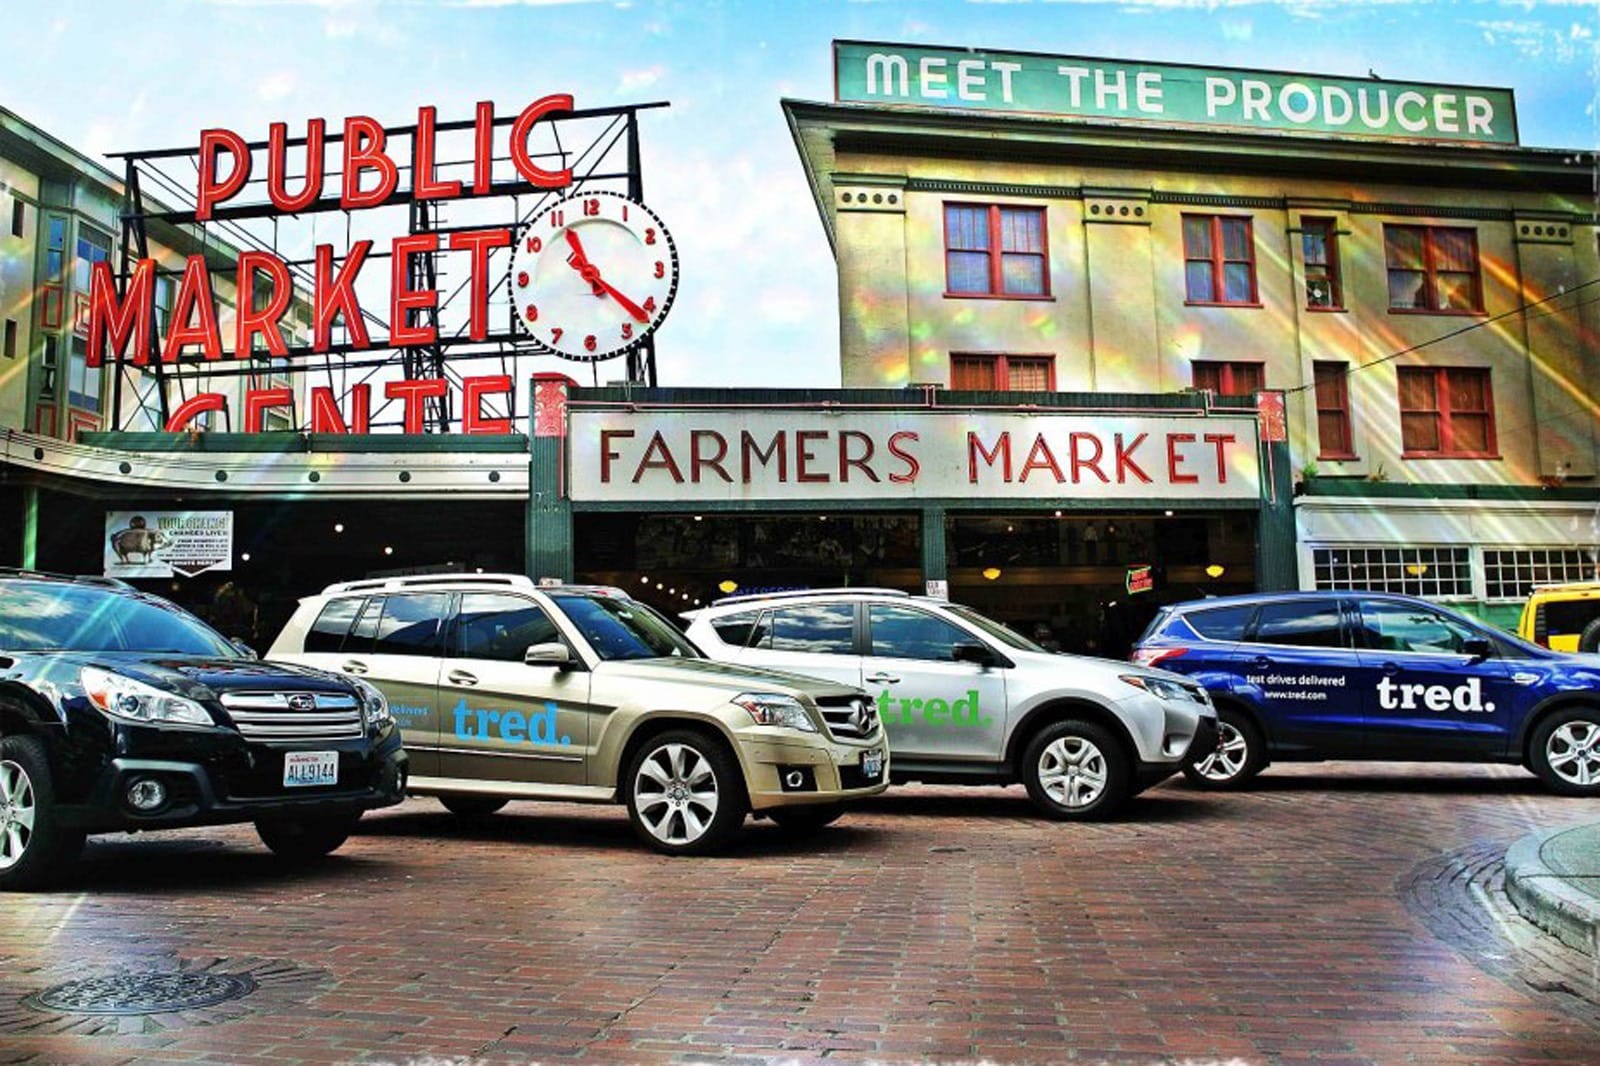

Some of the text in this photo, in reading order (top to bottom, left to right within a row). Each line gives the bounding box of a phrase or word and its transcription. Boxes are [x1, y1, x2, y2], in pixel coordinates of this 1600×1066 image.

[865, 53, 1494, 136] MEET THE PRODUCER
[196, 94, 574, 220] PUBLIC
[583, 199, 600, 216] 12
[551, 210, 564, 227] 11
[526, 236, 542, 253] 10
[645, 228, 656, 245] 2
[654, 260, 665, 279] 3
[517, 271, 530, 289] 9
[86, 229, 513, 368] MARKET
[525, 303, 538, 322] 8
[550, 327, 563, 344] 7
[621, 322, 633, 340] 5
[584, 335, 597, 352] 6
[599, 428, 1236, 484] FARMERS MARKET
[1246, 674, 1346, 687] test drives delivered
[1264, 691, 1328, 700] www.tred.com
[1376, 676, 1496, 712] tred.
[875, 689, 993, 727] tred.
[453, 697, 571, 747] tred.
[287, 763, 335, 781] ALL9144
